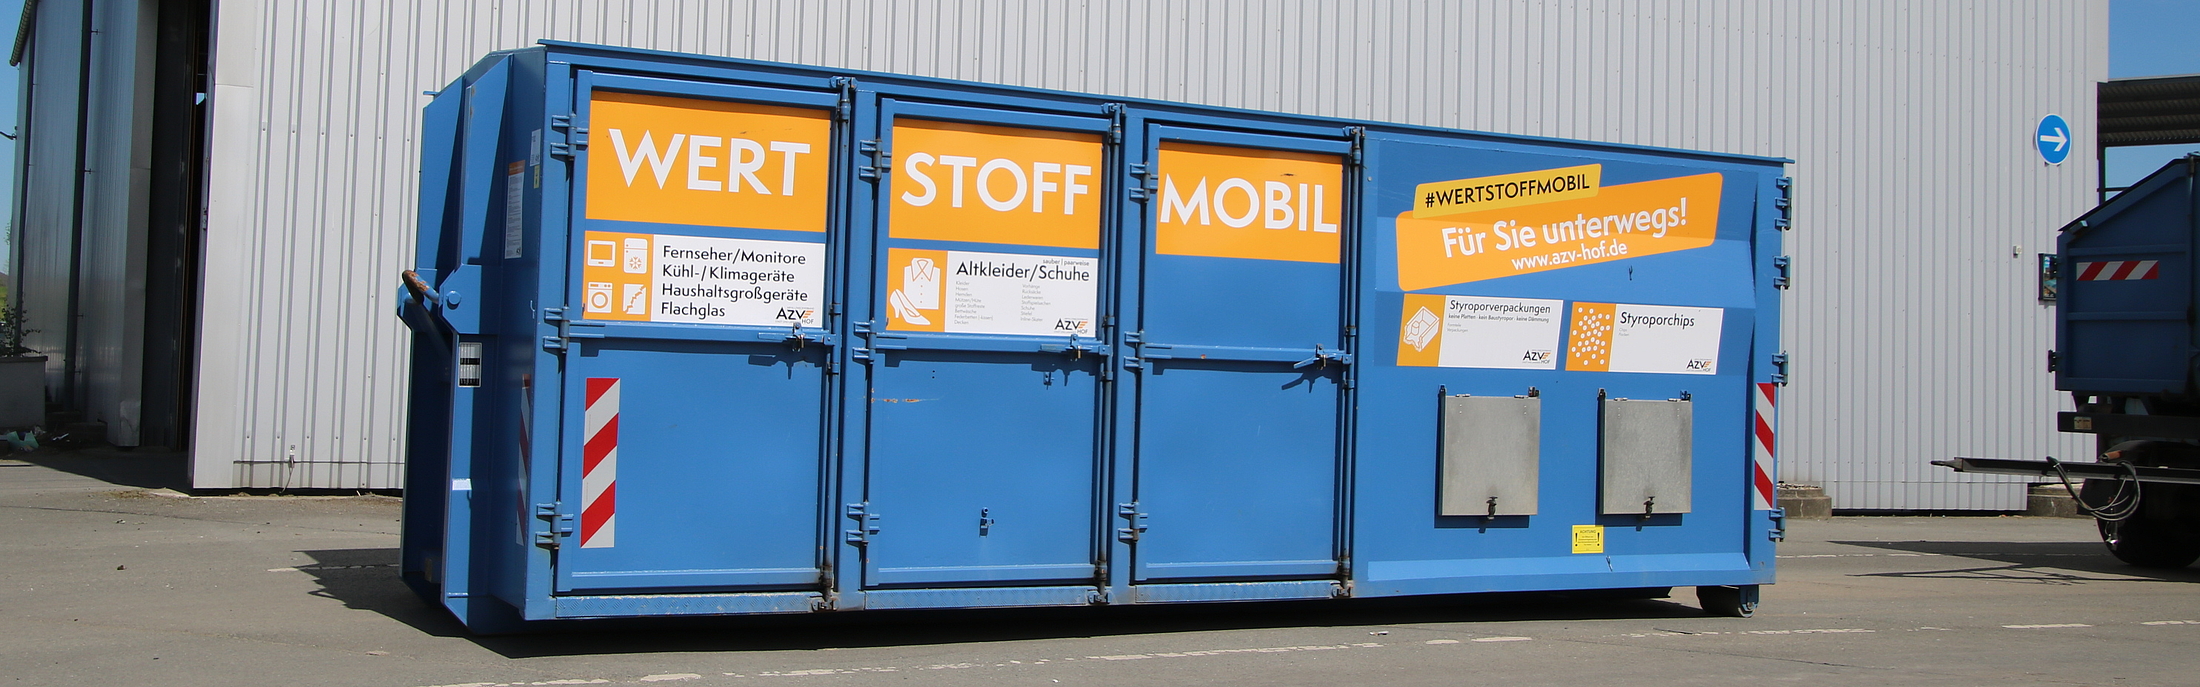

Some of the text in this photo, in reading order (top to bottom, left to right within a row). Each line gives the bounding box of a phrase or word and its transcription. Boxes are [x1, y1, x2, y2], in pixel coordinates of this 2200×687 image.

[608, 128, 811, 197] WERT
[901, 152, 1092, 215] STOFF
[1425, 174, 1590, 208] #WERTSTOFFMOBIL
[1160, 173, 1337, 233] MOBIL
[1441, 197, 1687, 258] Für Sie unterwegs!
[663, 245, 806, 265] Fernseher/Monitore
[1511, 239, 1628, 270] www.azv-hof.de
[956, 261, 1090, 282] Altkleider/Schuhe
[661, 283, 808, 304] Haushaltsgroßgeräte
[660, 301, 726, 319] Flachglas
[1450, 300, 1551, 316] Styroporverpackungen
[1620, 311, 1695, 329] Styroporchips
